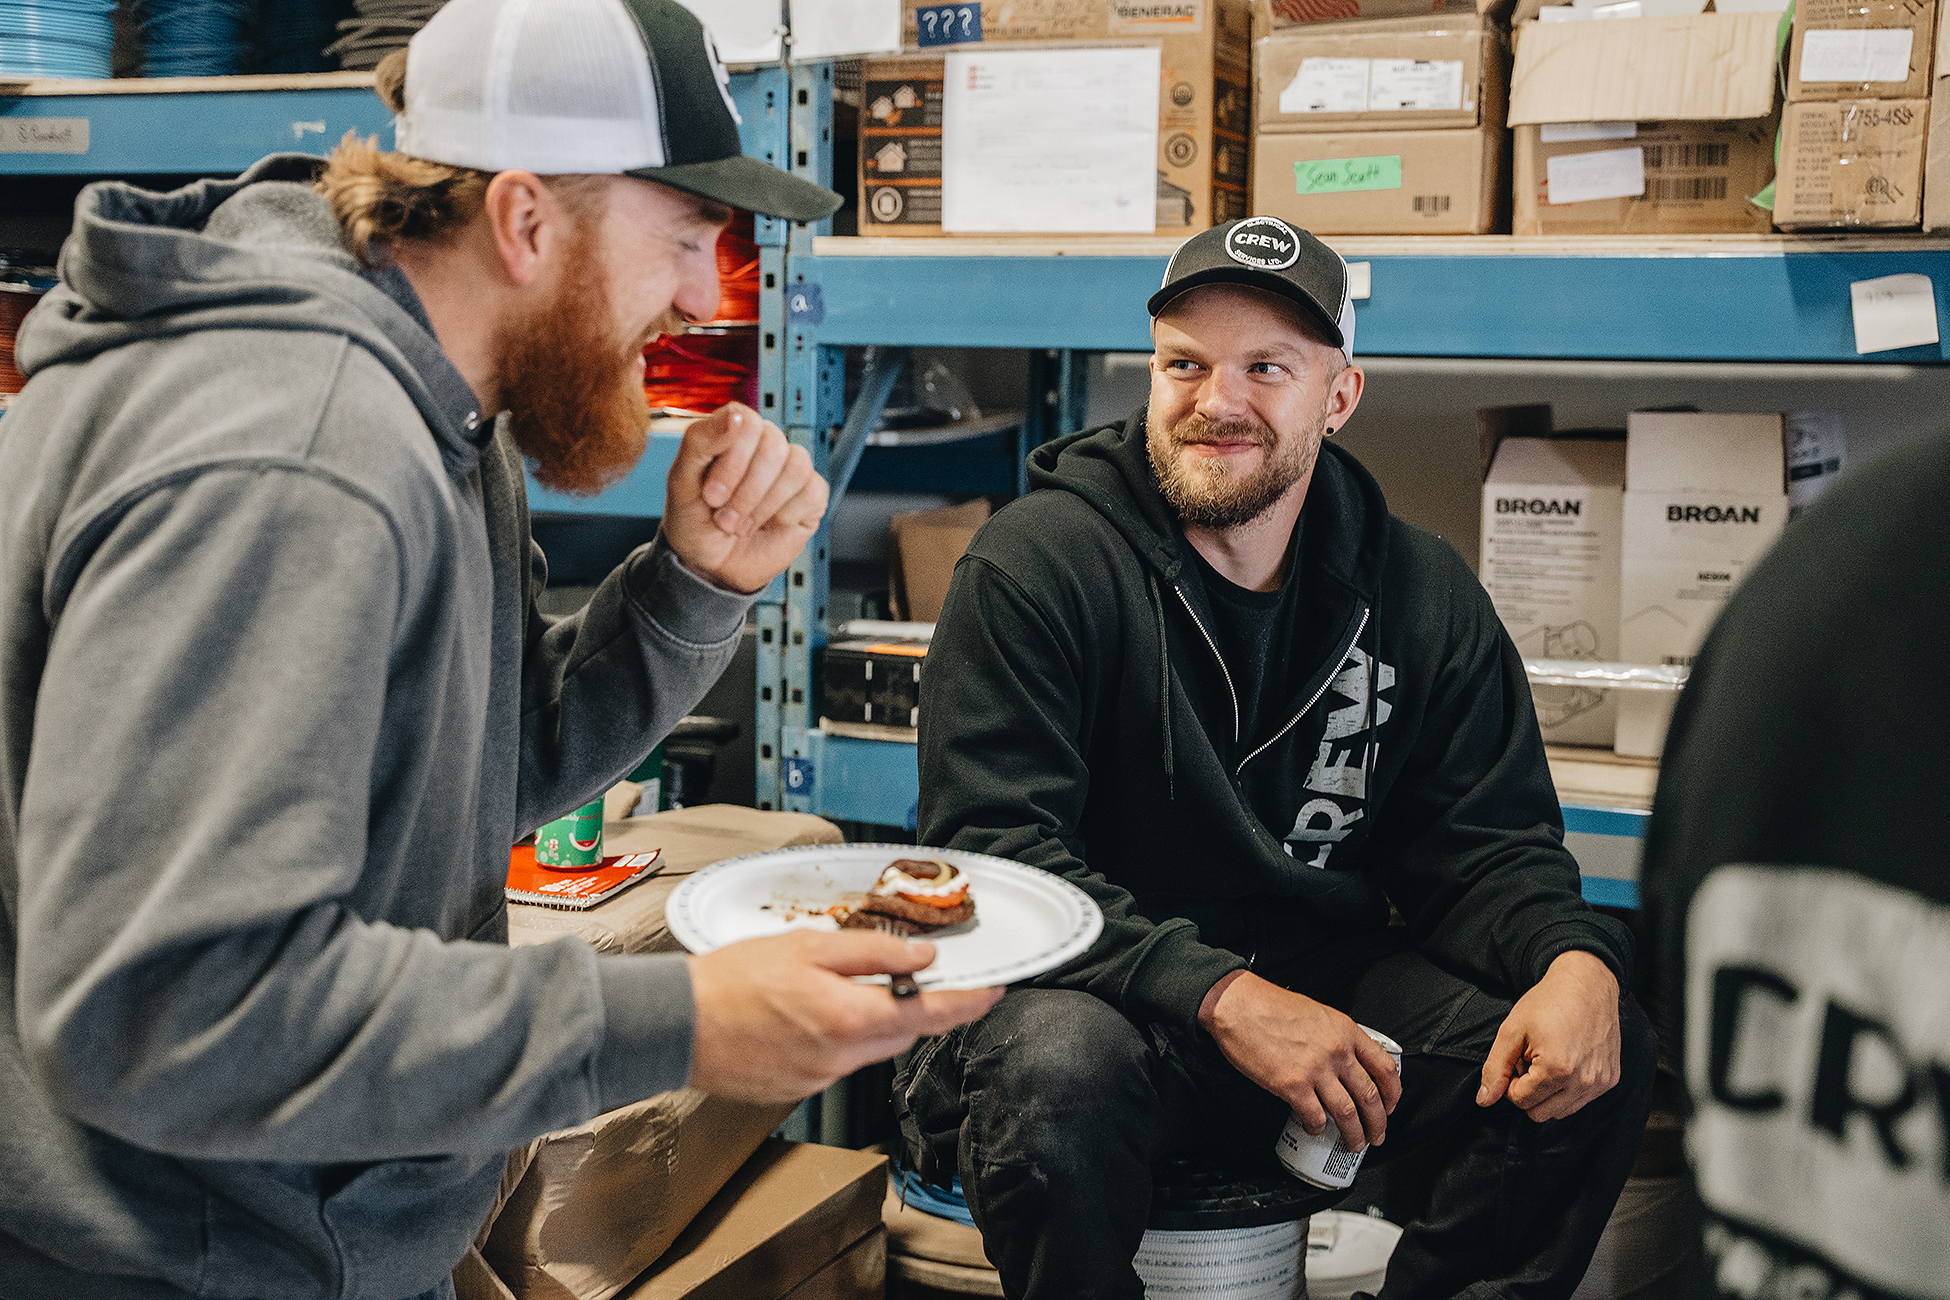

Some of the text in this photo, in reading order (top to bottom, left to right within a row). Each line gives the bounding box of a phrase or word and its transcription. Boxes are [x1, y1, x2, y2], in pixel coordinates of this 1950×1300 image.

[1117, 4, 1195, 19] GENERAC
[1234, 233, 1291, 252] CREW
[1234, 249, 1266, 265] SERVICES
[1495, 498, 1581, 517] BROAN
[1667, 505, 1760, 524] BROAN
